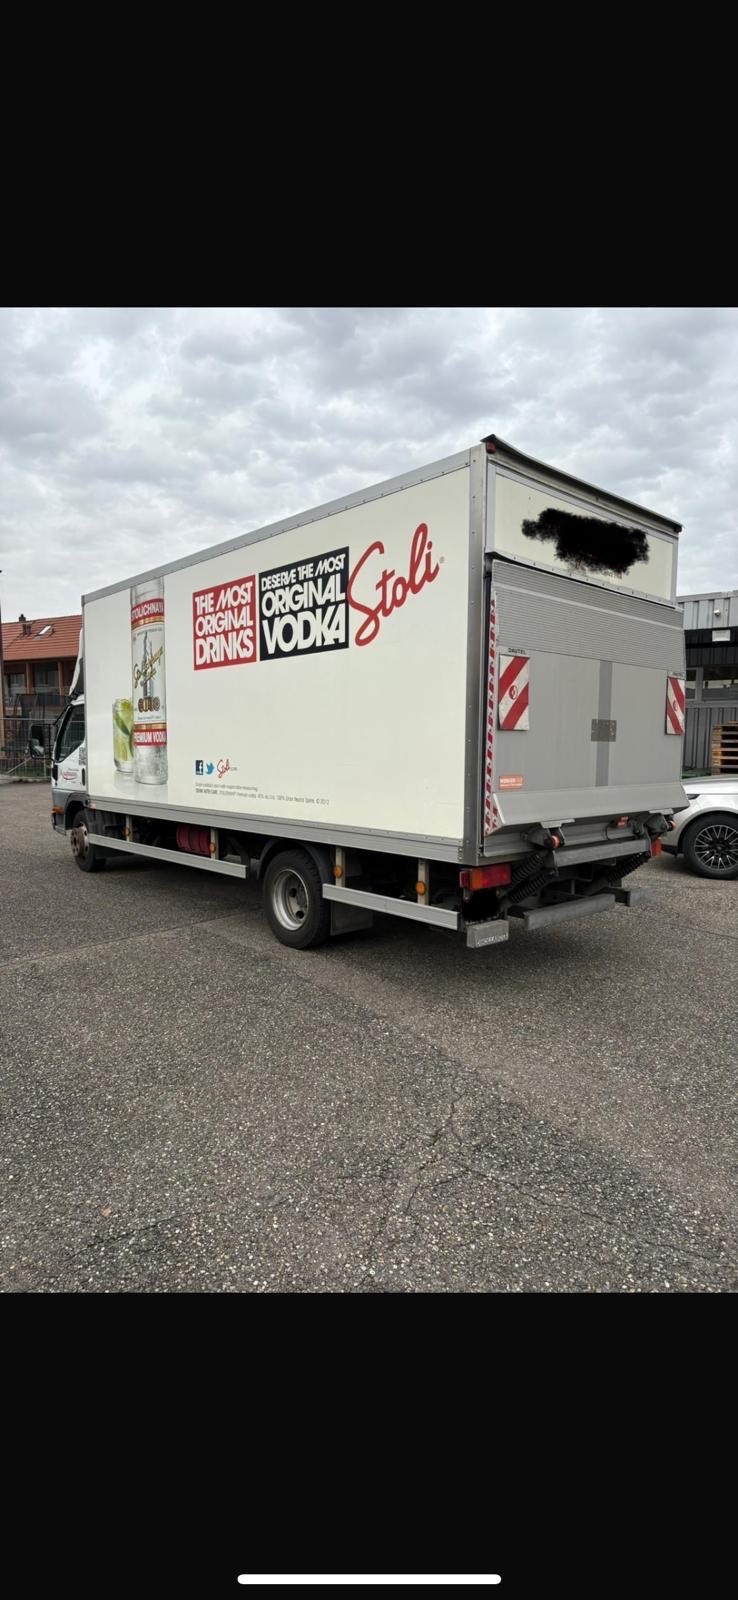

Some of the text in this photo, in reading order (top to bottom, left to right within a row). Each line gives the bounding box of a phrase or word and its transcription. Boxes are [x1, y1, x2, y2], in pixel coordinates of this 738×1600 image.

[261, 554, 346, 592] DESERVE THE MOST
[347, 523, 440, 647] Stoli
[195, 581, 253, 615] THE MOST
[261, 573, 346, 617] ORIGINAL
[195, 605, 253, 637] ORIGINAL
[262, 602, 346, 655] VODKA
[195, 628, 254, 665] DRINKS
